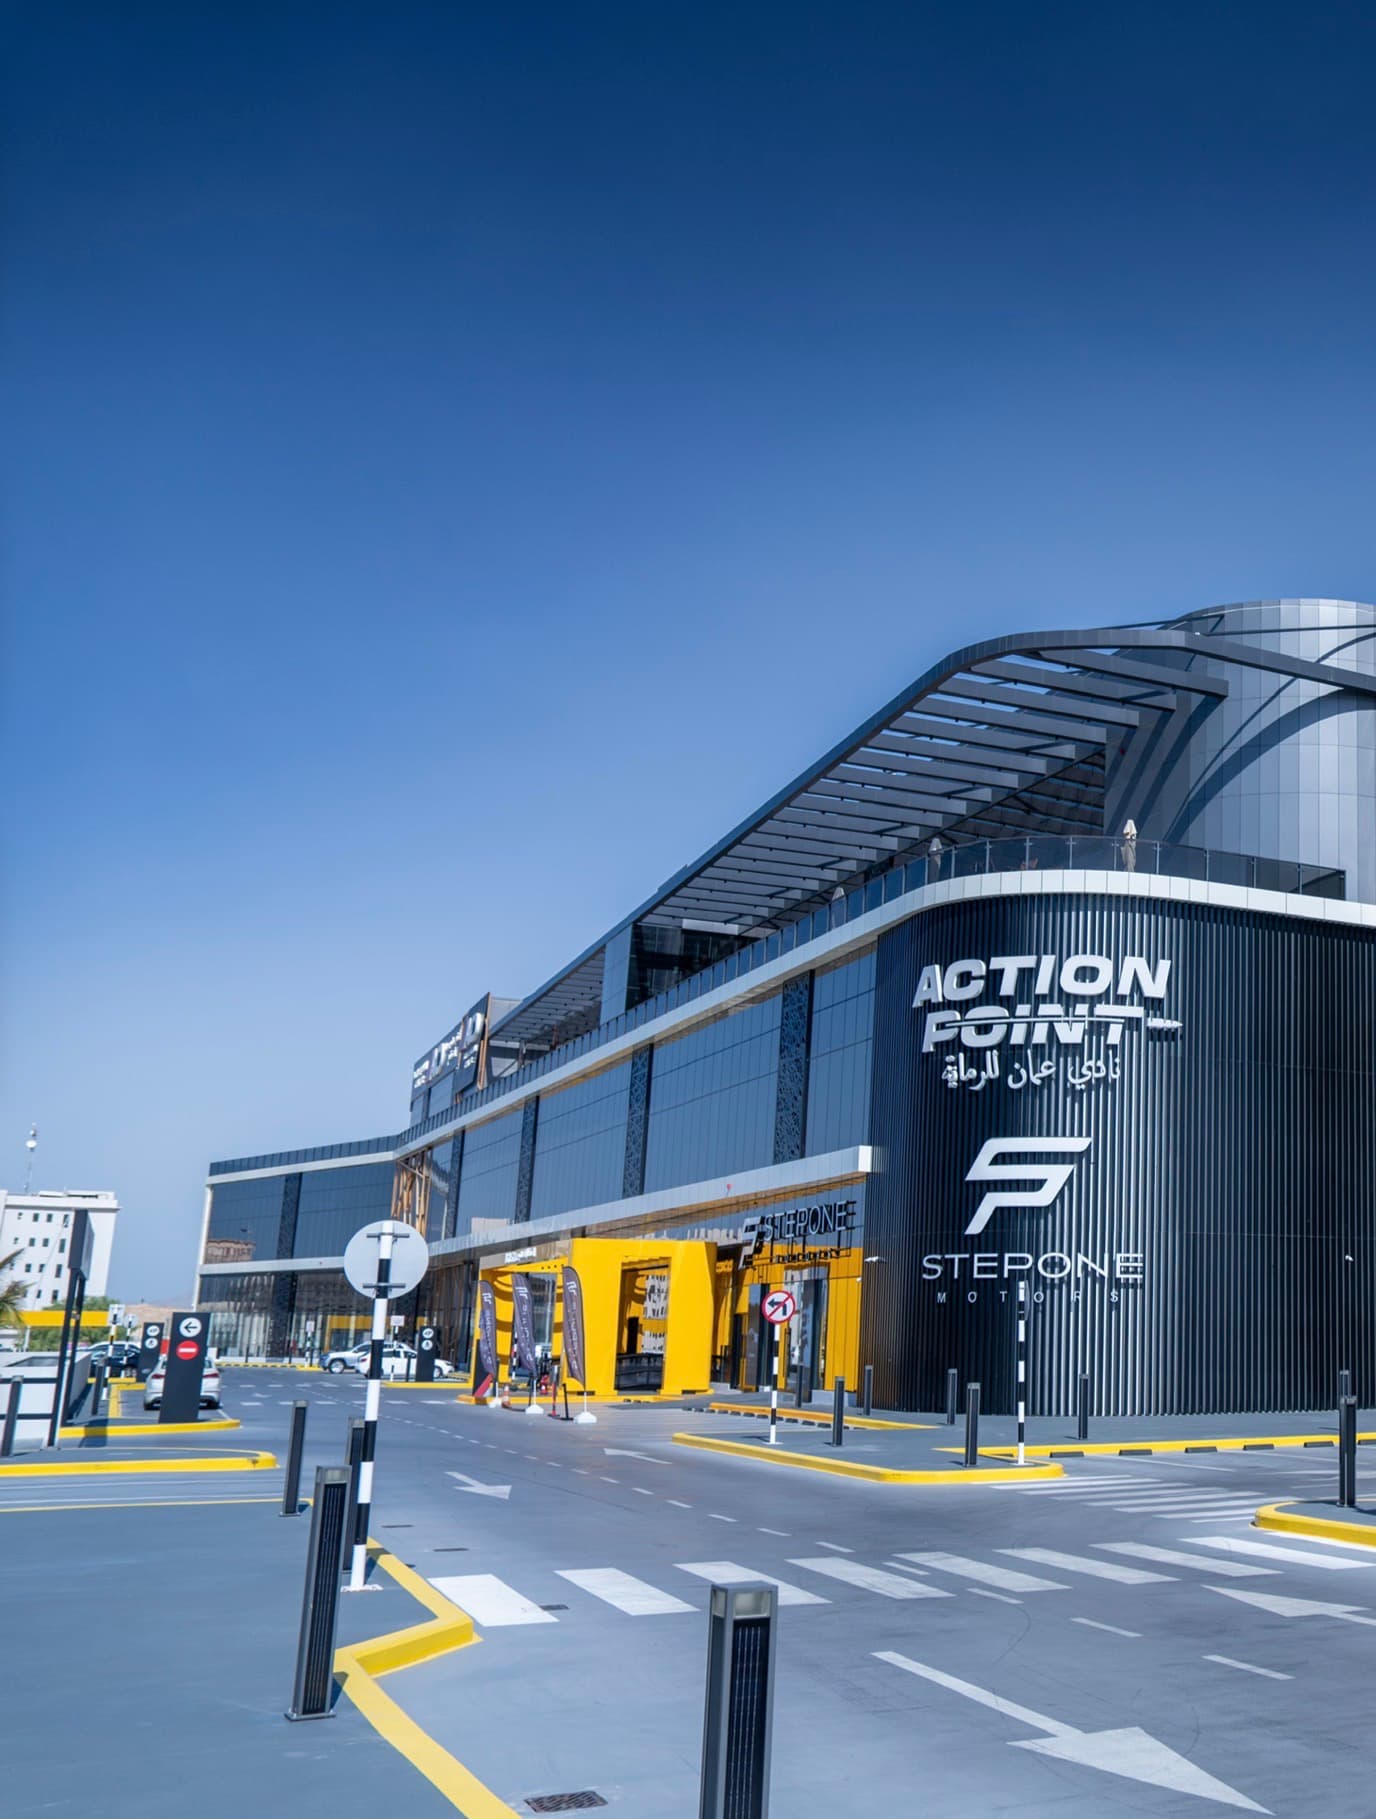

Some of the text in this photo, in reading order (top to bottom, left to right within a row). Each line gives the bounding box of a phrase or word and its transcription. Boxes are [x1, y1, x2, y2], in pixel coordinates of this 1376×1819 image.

[912, 954, 1172, 1008] ACTION
[922, 1004, 1145, 1053] POINT
[941, 1049, 1121, 1091] نادي عمان للرماية
[765, 1200, 848, 1242] STEPONE
[921, 1252, 1144, 1280] STEPONE
[937, 1290, 1119, 1304] MOTORS
